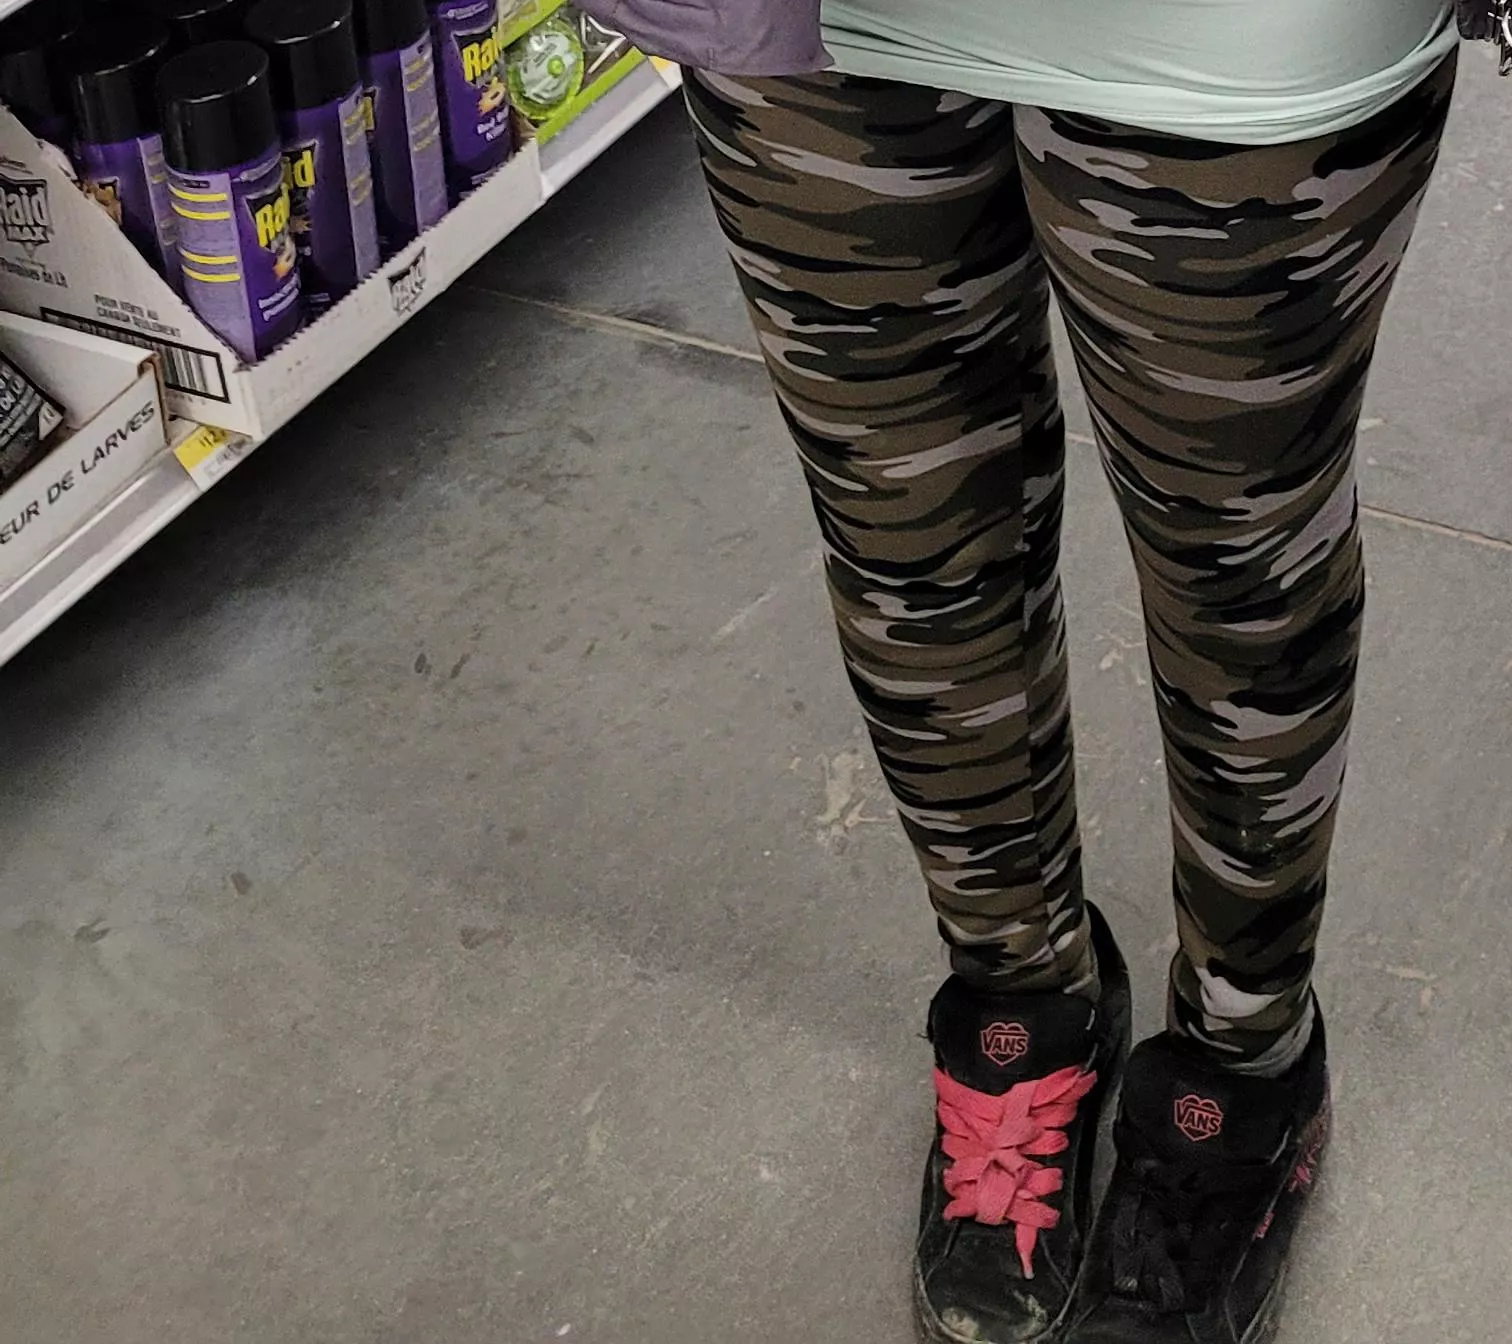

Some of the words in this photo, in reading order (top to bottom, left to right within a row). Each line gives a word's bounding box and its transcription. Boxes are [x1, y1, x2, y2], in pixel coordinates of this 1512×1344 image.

[462, 26, 502, 82] Rai
[0, 500, 41, 545] EUR
[47, 469, 76, 505] DE
[81, 399, 155, 475] LARVES
[982, 1029, 1029, 1056] VANS
[1175, 1100, 1223, 1134] VANS
